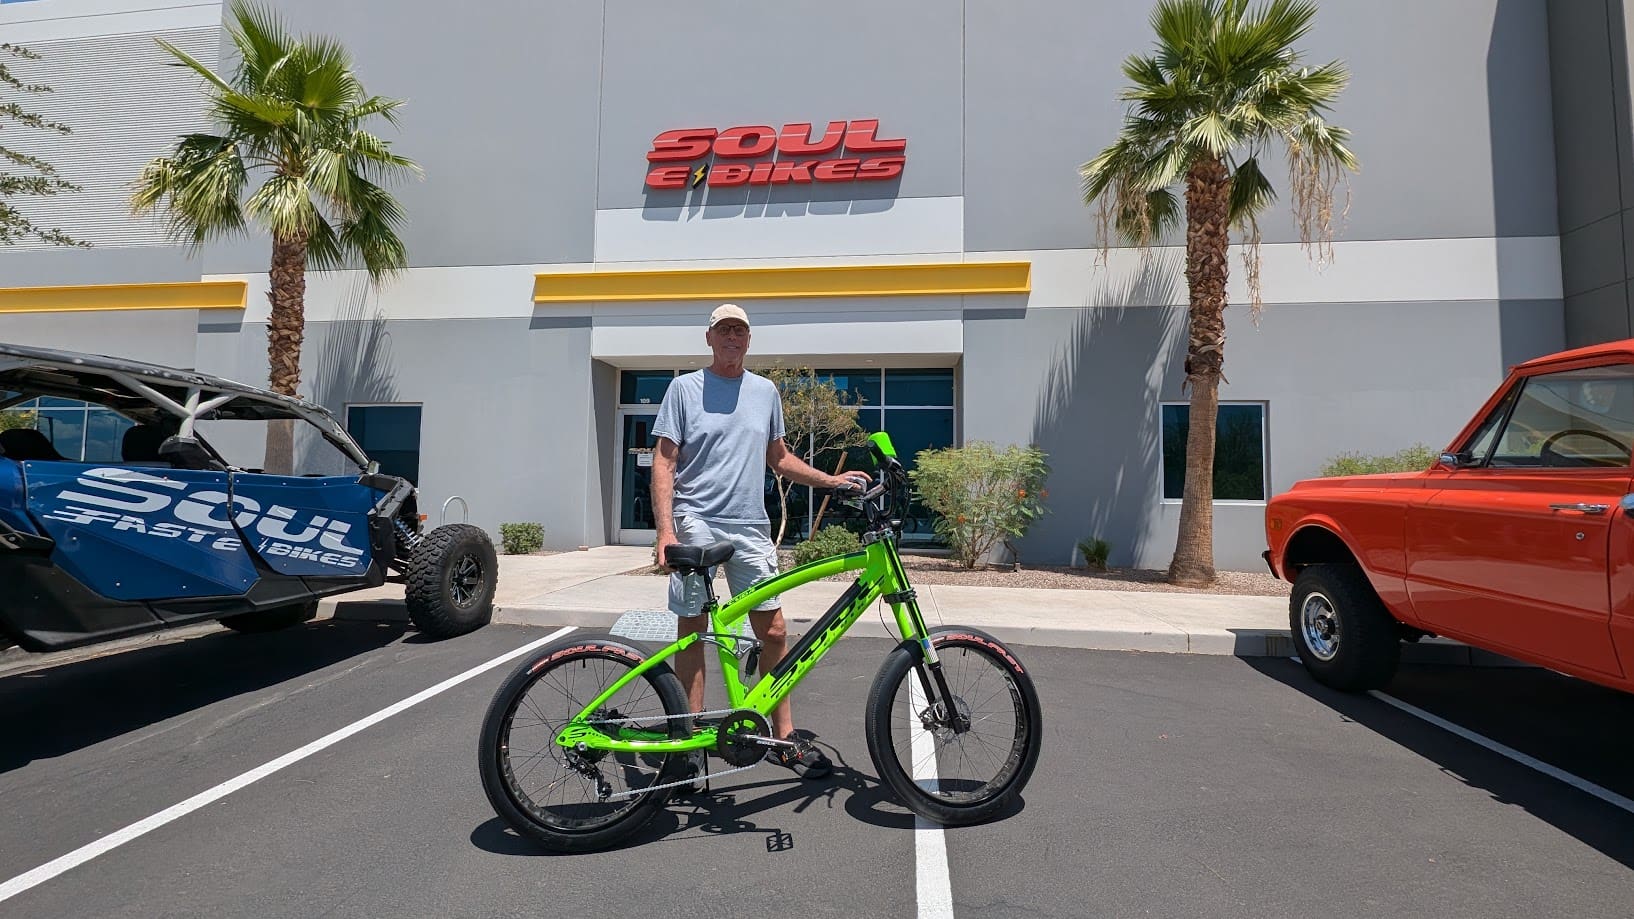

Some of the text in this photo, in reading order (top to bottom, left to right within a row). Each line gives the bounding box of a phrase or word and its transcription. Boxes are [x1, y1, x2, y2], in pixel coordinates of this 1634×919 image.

[646, 119, 907, 161] SOUL
[645, 156, 906, 189] E BIKES
[56, 467, 364, 555] SOUL
[267, 543, 358, 568] BIKES
